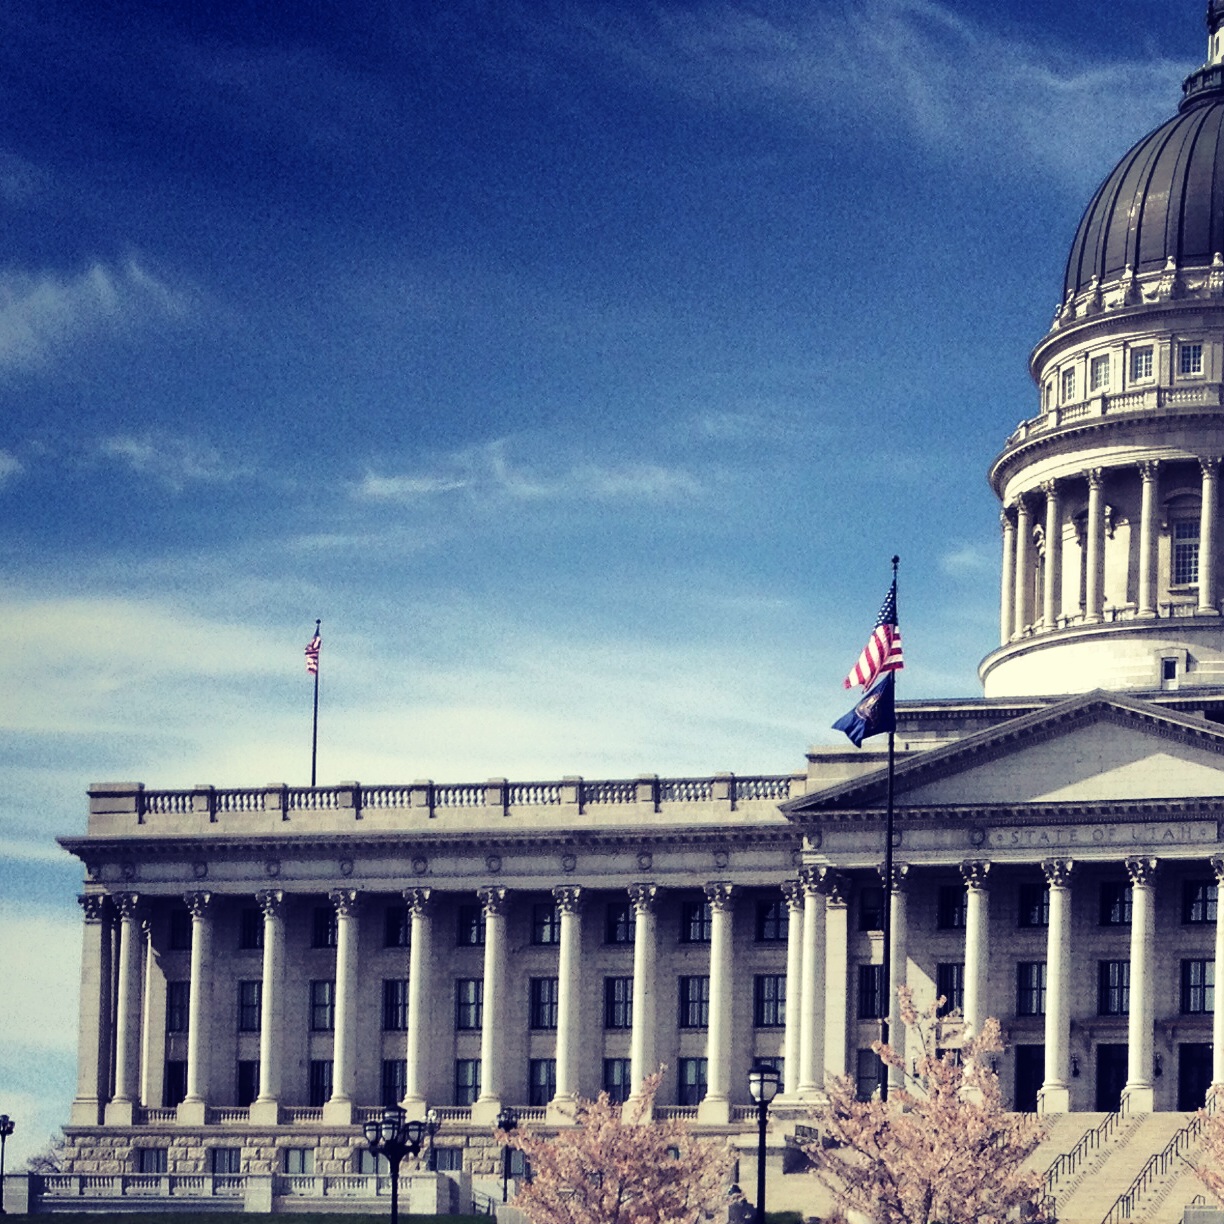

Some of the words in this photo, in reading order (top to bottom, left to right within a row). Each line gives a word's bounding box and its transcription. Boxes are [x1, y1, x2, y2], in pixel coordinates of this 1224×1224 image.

[1010, 829, 1077, 845] STATE
[1092, 827, 1116, 842] OF
[1131, 823, 1192, 841] UTAH
